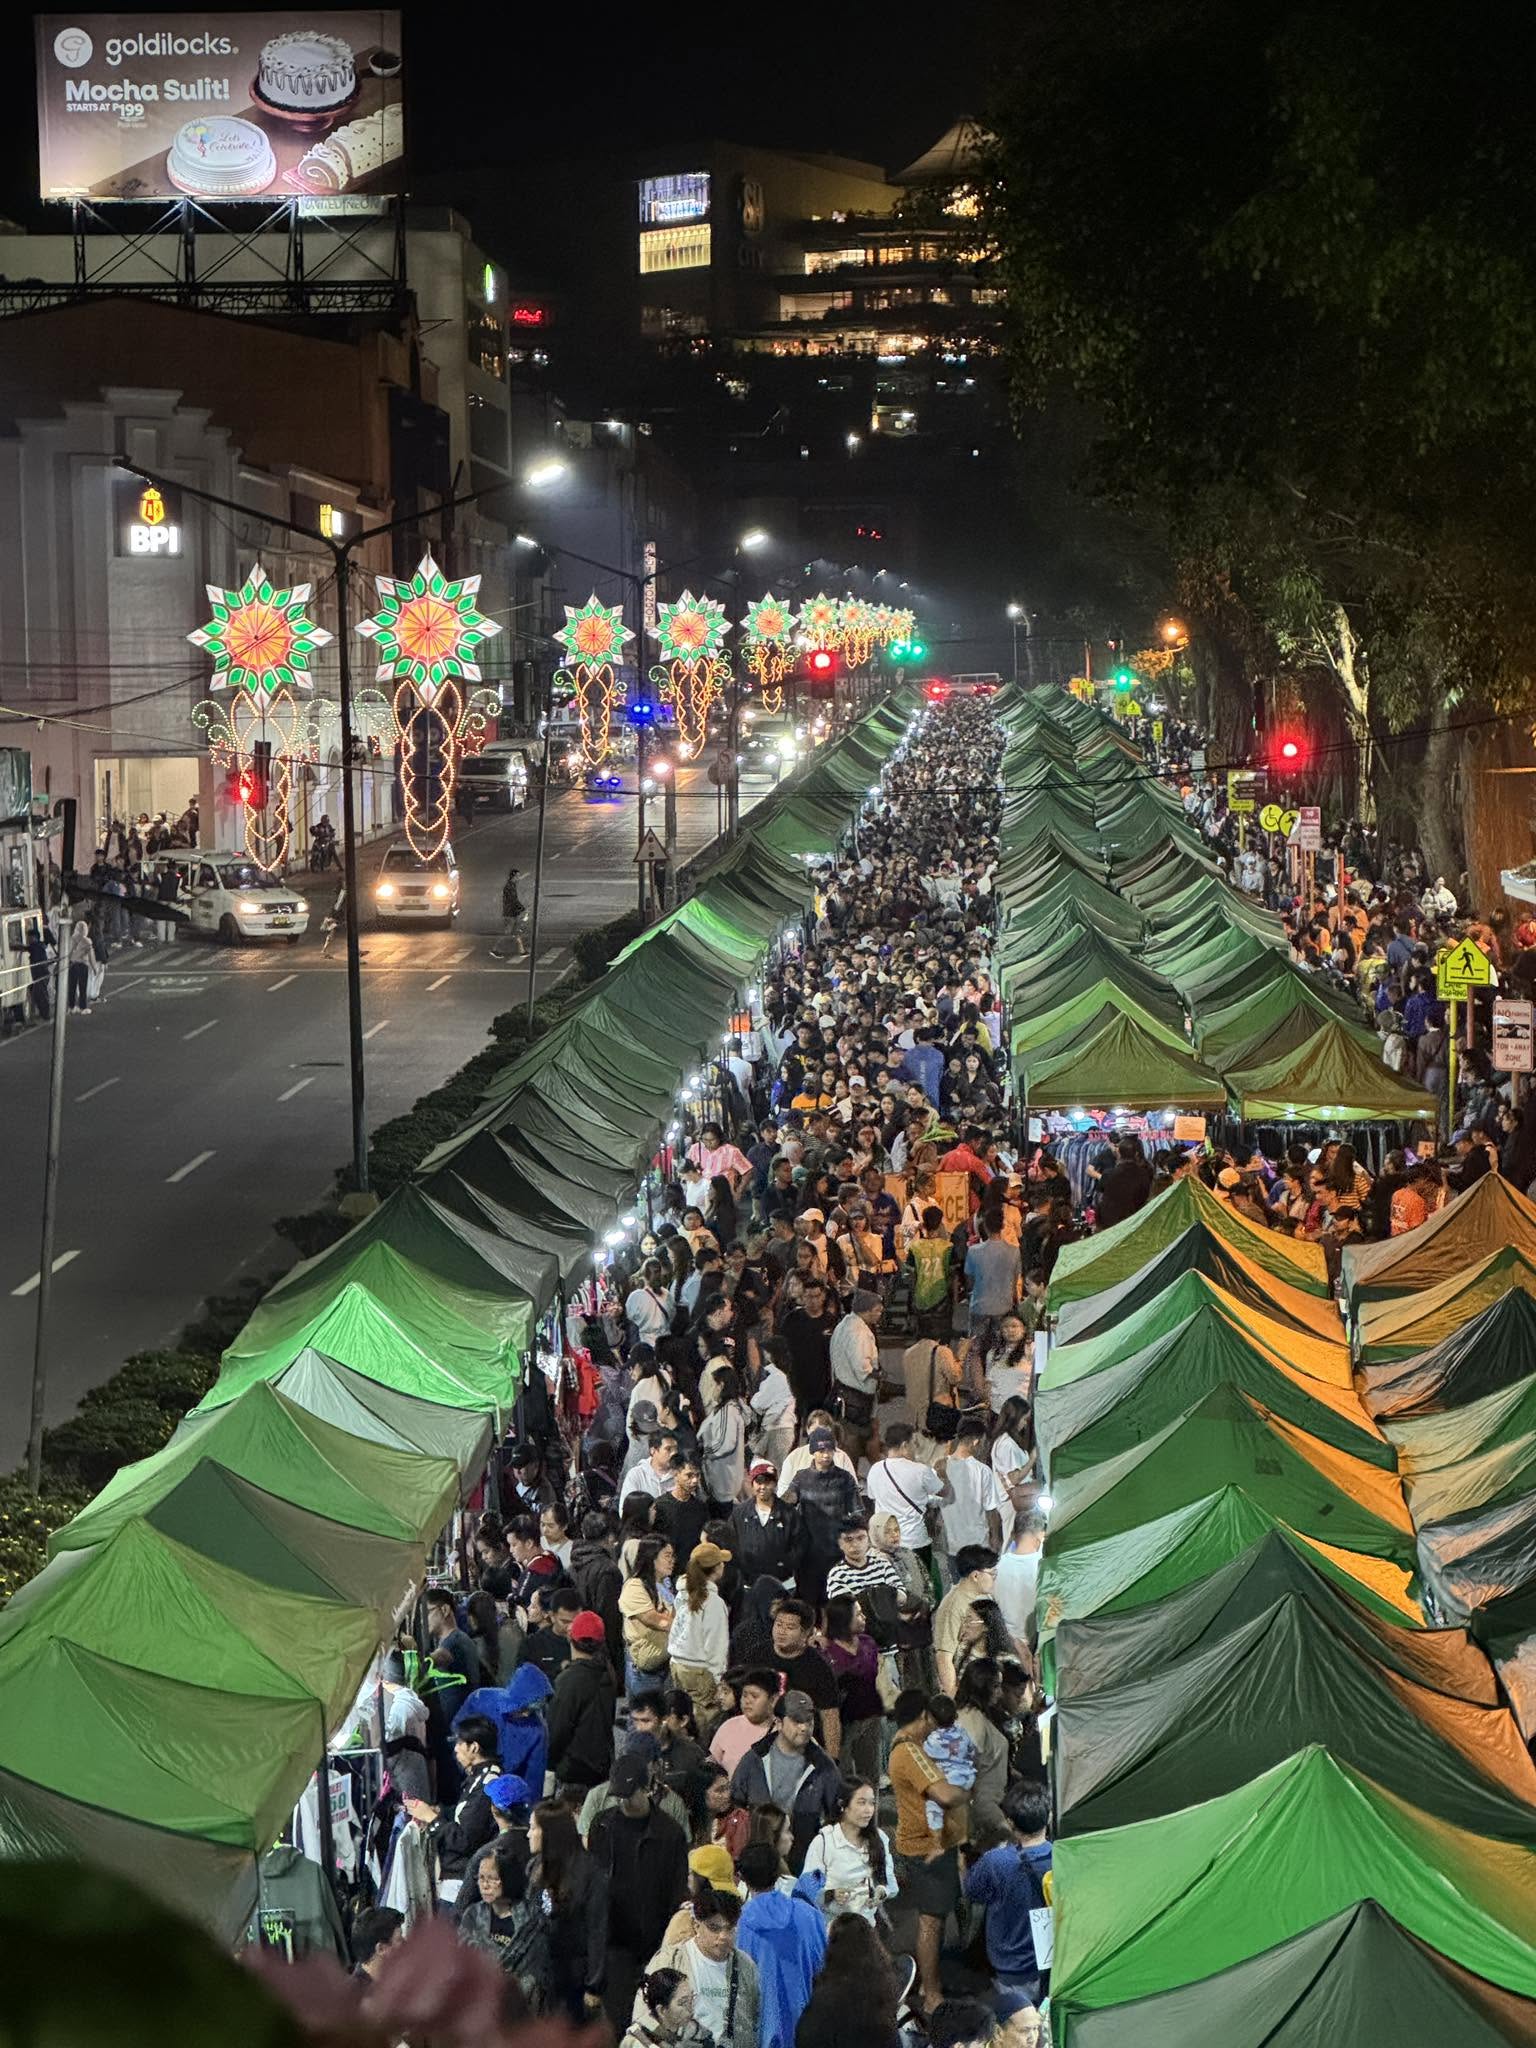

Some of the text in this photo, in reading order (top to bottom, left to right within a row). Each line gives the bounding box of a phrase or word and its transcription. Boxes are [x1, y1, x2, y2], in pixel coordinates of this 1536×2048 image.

[65, 77, 230, 102] Mocha Sulit!
[66, 103, 98, 113] STARTS
[99, 103, 111, 112] AT
[130, 525, 178, 553] BPI
[1497, 1009, 1511, 1017] NO
[1504, 1054, 1522, 1062] ZONE
